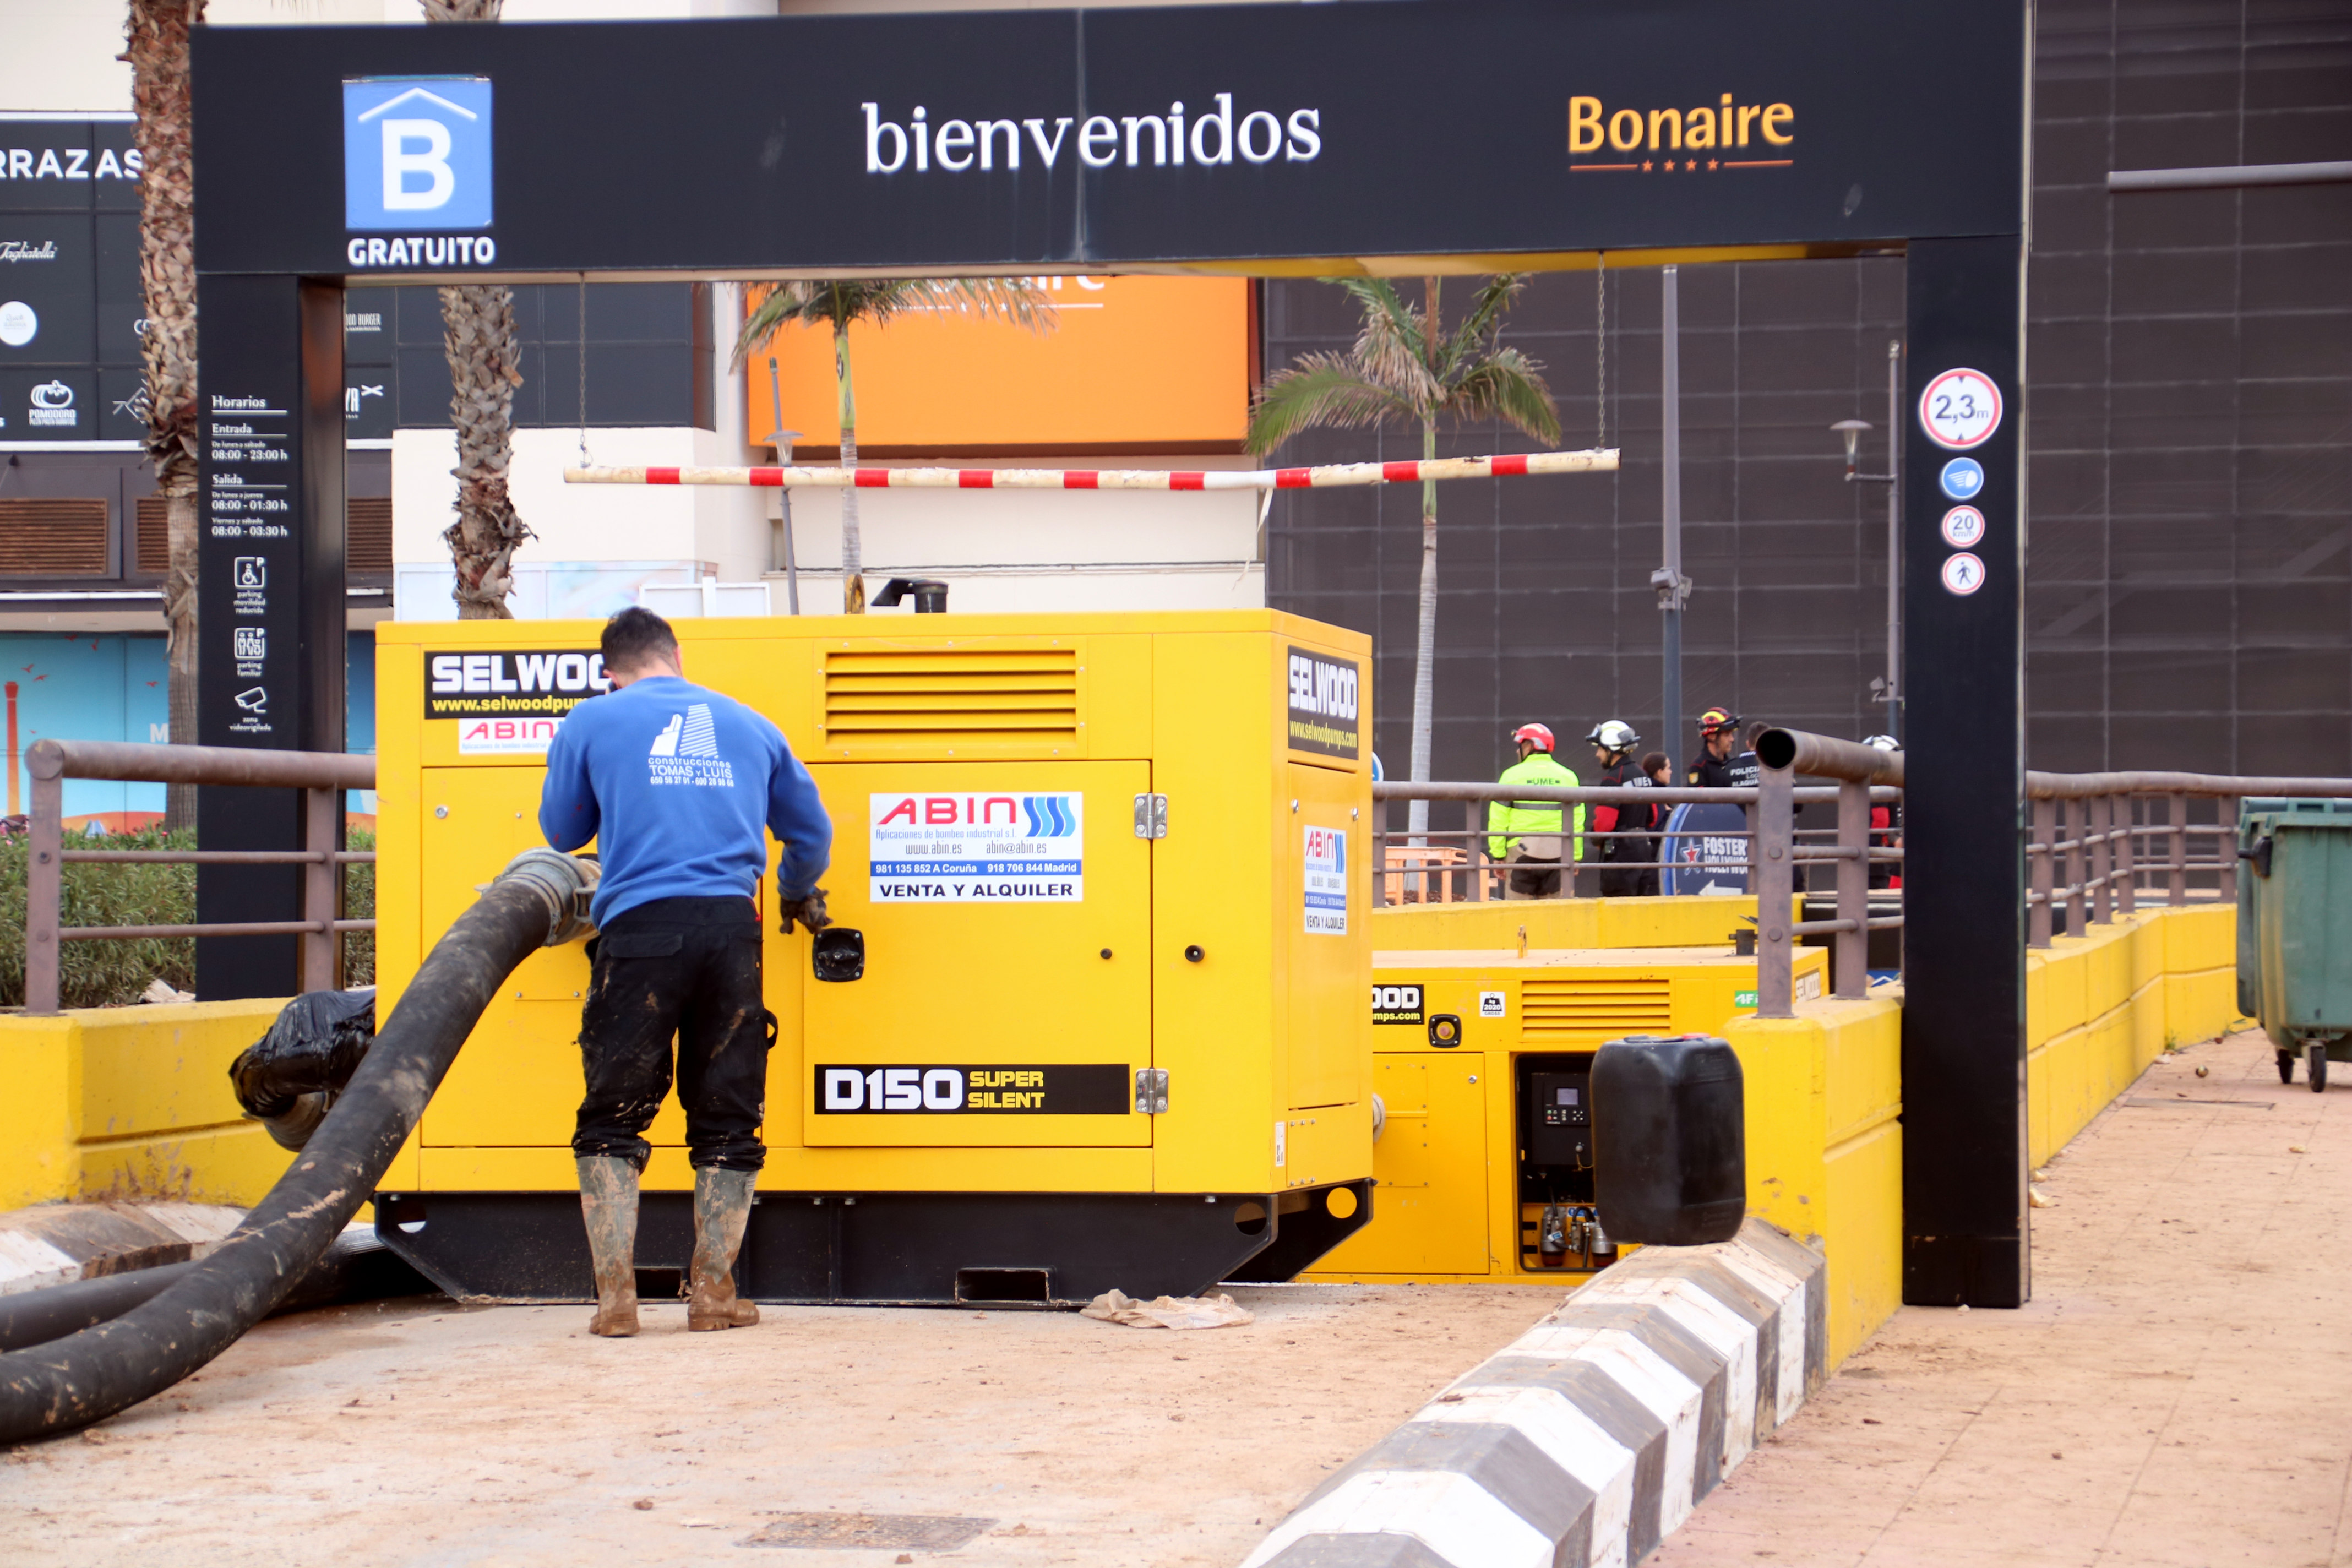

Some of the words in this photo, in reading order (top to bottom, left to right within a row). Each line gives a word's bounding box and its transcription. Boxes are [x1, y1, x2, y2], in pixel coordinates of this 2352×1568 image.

[1568, 93, 1794, 153] Bonaire
[861, 92, 1321, 172] bienvenidos
[0, 149, 143, 179] RAZAS
[382, 118, 455, 211] B
[347, 236, 496, 266] GRATUITO
[358, 313, 382, 326] BURGER
[211, 395, 266, 408] Horarios
[29, 409, 77, 418] POMODORO
[211, 423, 253, 433] Entrada
[211, 449, 241, 461] 08:00
[249, 449, 279, 461] 23:00
[280, 449, 288, 461] h
[212, 473, 243, 484] Salida
[211, 500, 241, 511] 08:00
[249, 500, 279, 511] 01:30
[280, 499, 288, 511] h
[1953, 515, 1974, 530] 20
[211, 526, 241, 537] 08:00
[249, 526, 279, 537] 03:30
[280, 525, 288, 537] h
[1952, 529, 1975, 538] km/h
[256, 557, 265, 568] P
[237, 590, 262, 600] parking
[233, 598, 266, 607] movilidad
[235, 606, 264, 614] reducida
[256, 628, 265, 638] P
[237, 662, 262, 670] parking
[237, 669, 262, 677] familiar
[1289, 655, 1358, 720] SELWOOD
[150, 723, 168, 743] M
[229, 723, 272, 733] videovigilada
[464, 721, 554, 740] ABIN
[1289, 720, 1357, 750] www.selwoodpumps.com
[648, 756, 731, 769] construcciones
[649, 765, 694, 777] TOMAS
[703, 766, 733, 779] LUIS
[650, 776, 663, 785] 650
[665, 776, 673, 785] 58
[695, 777, 707, 786] 600
[709, 778, 717, 786] 28
[717, 778, 726, 787] 98
[726, 779, 734, 787] 68
[876, 797, 1016, 825] ABIN
[876, 829, 922, 841] Aplicaciones
[924, 829, 933, 839] de
[935, 829, 964, 839] bombeo
[967, 828, 1003, 838] industrial
[1005, 828, 1017, 838] s.l.
[906, 840, 962, 854] www.abin.es
[986, 840, 1047, 854] abin@abin.es
[1305, 830, 1335, 859] ABIN
[876, 864, 892, 873] 981
[895, 864, 912, 873] 135
[914, 864, 931, 873] 852
[933, 864, 940, 873] A
[943, 863, 977, 873] Coruña
[987, 863, 1005, 873] 918
[1007, 863, 1024, 873] 706
[1026, 863, 1043, 872] 844
[1044, 863, 1077, 872] Madrid
[880, 884, 946, 897] VENTA
[953, 884, 966, 896] Y
[972, 884, 1073, 897] ALQUILER
[1306, 914, 1320, 928] VENTA
[1321, 916, 1325, 928] Y
[1325, 916, 1345, 929] ALQUILER
[1373, 1012, 1420, 1022] mps.com
[970, 1071, 1044, 1087] SUPER
[825, 1069, 963, 1110] D150
[968, 1092, 1045, 1108] SILENT
